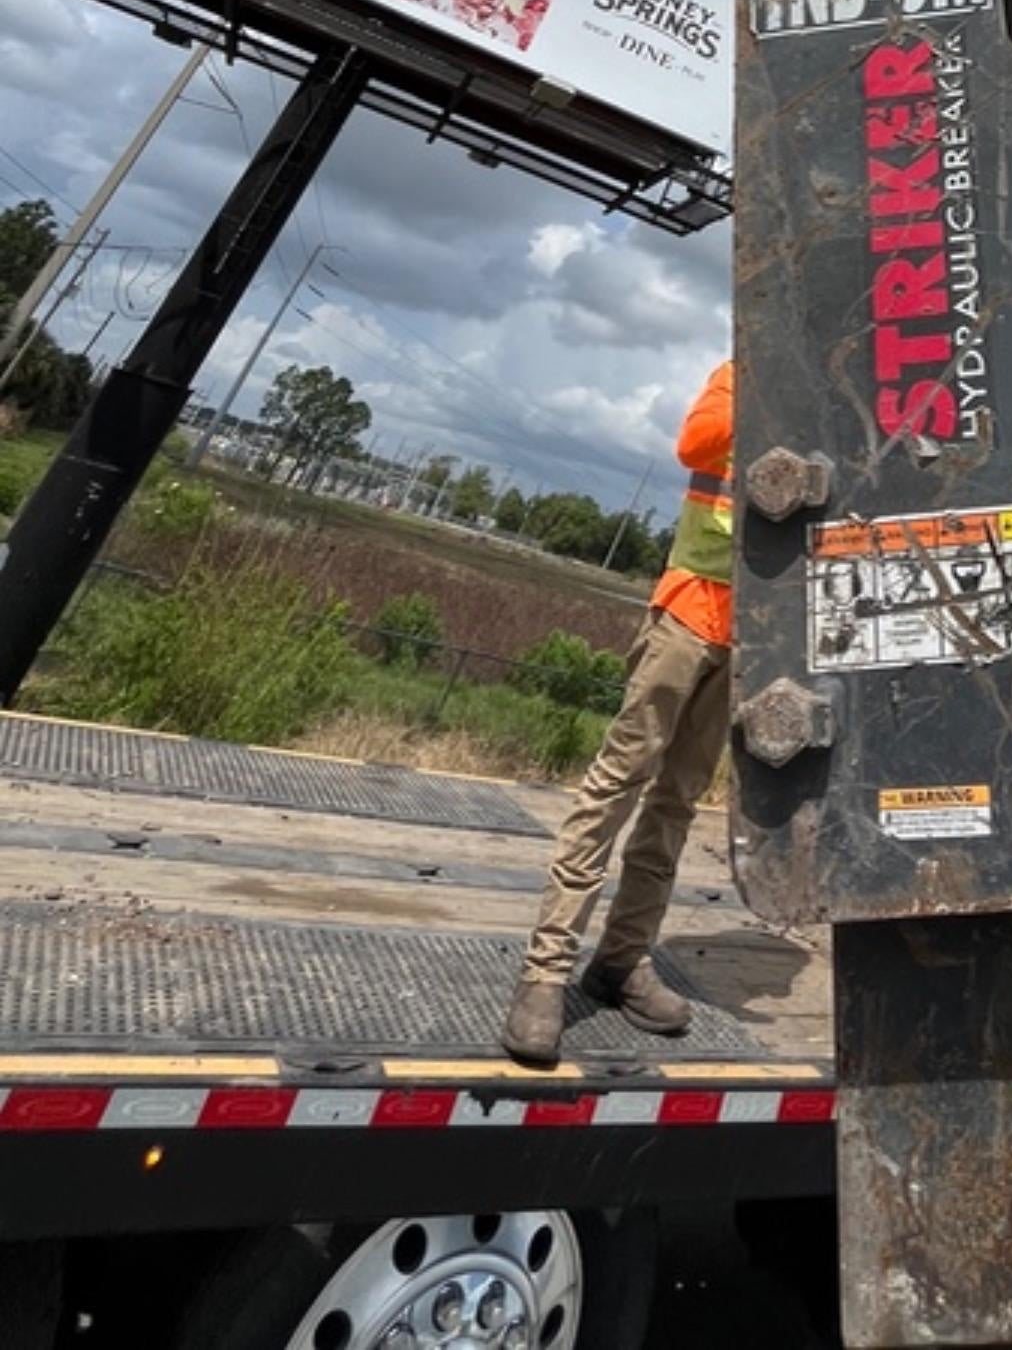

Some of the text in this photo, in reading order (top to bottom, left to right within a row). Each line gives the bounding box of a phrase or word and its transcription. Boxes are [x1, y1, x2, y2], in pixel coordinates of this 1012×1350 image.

[620, 33, 676, 70] DINE
[863, 41, 959, 438] STRIKER
[938, 34, 988, 439] HYDRAULIC BREAKER
